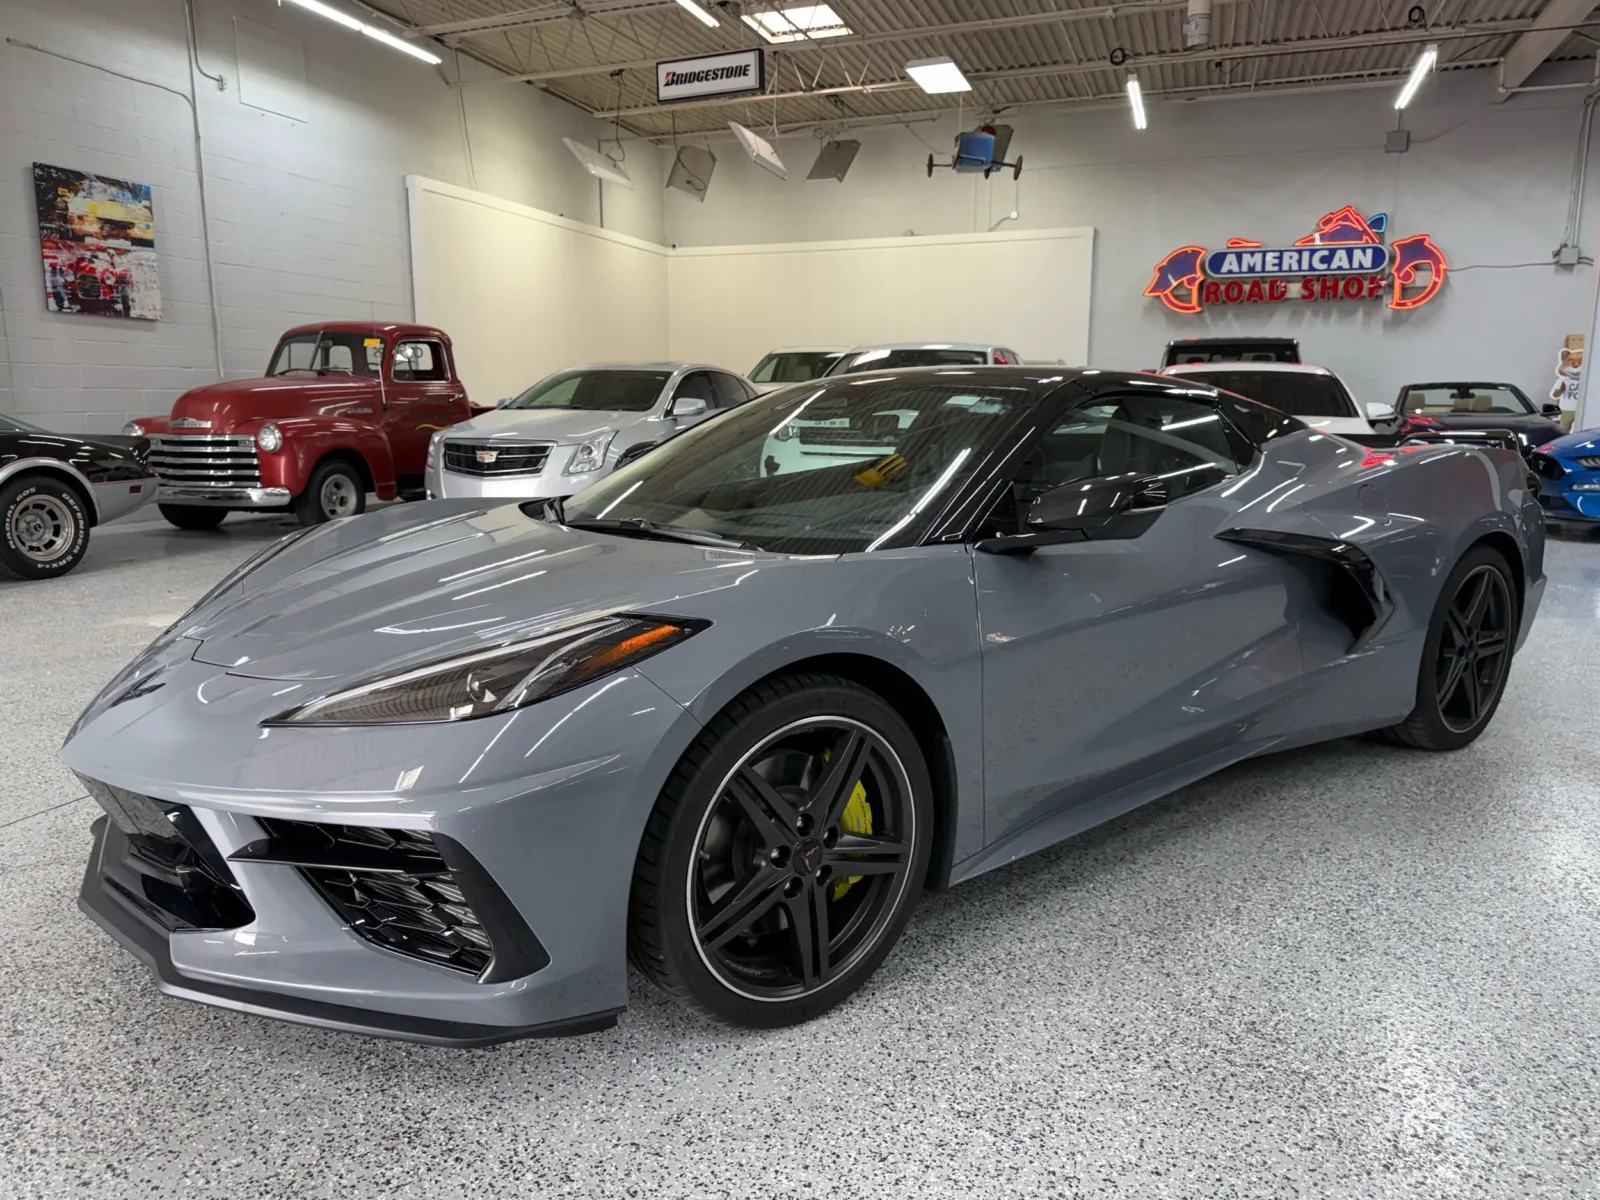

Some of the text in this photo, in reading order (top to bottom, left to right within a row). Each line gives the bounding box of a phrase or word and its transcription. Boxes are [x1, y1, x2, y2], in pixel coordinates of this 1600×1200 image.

[663, 63, 751, 87] BRIDGESTONE
[1219, 247, 1374, 274] AMERICAN
[1203, 275, 1387, 304] ROAD SHOP
[61, 493, 85, 554] DEFENDER
[724, 959, 762, 976] FORGED
